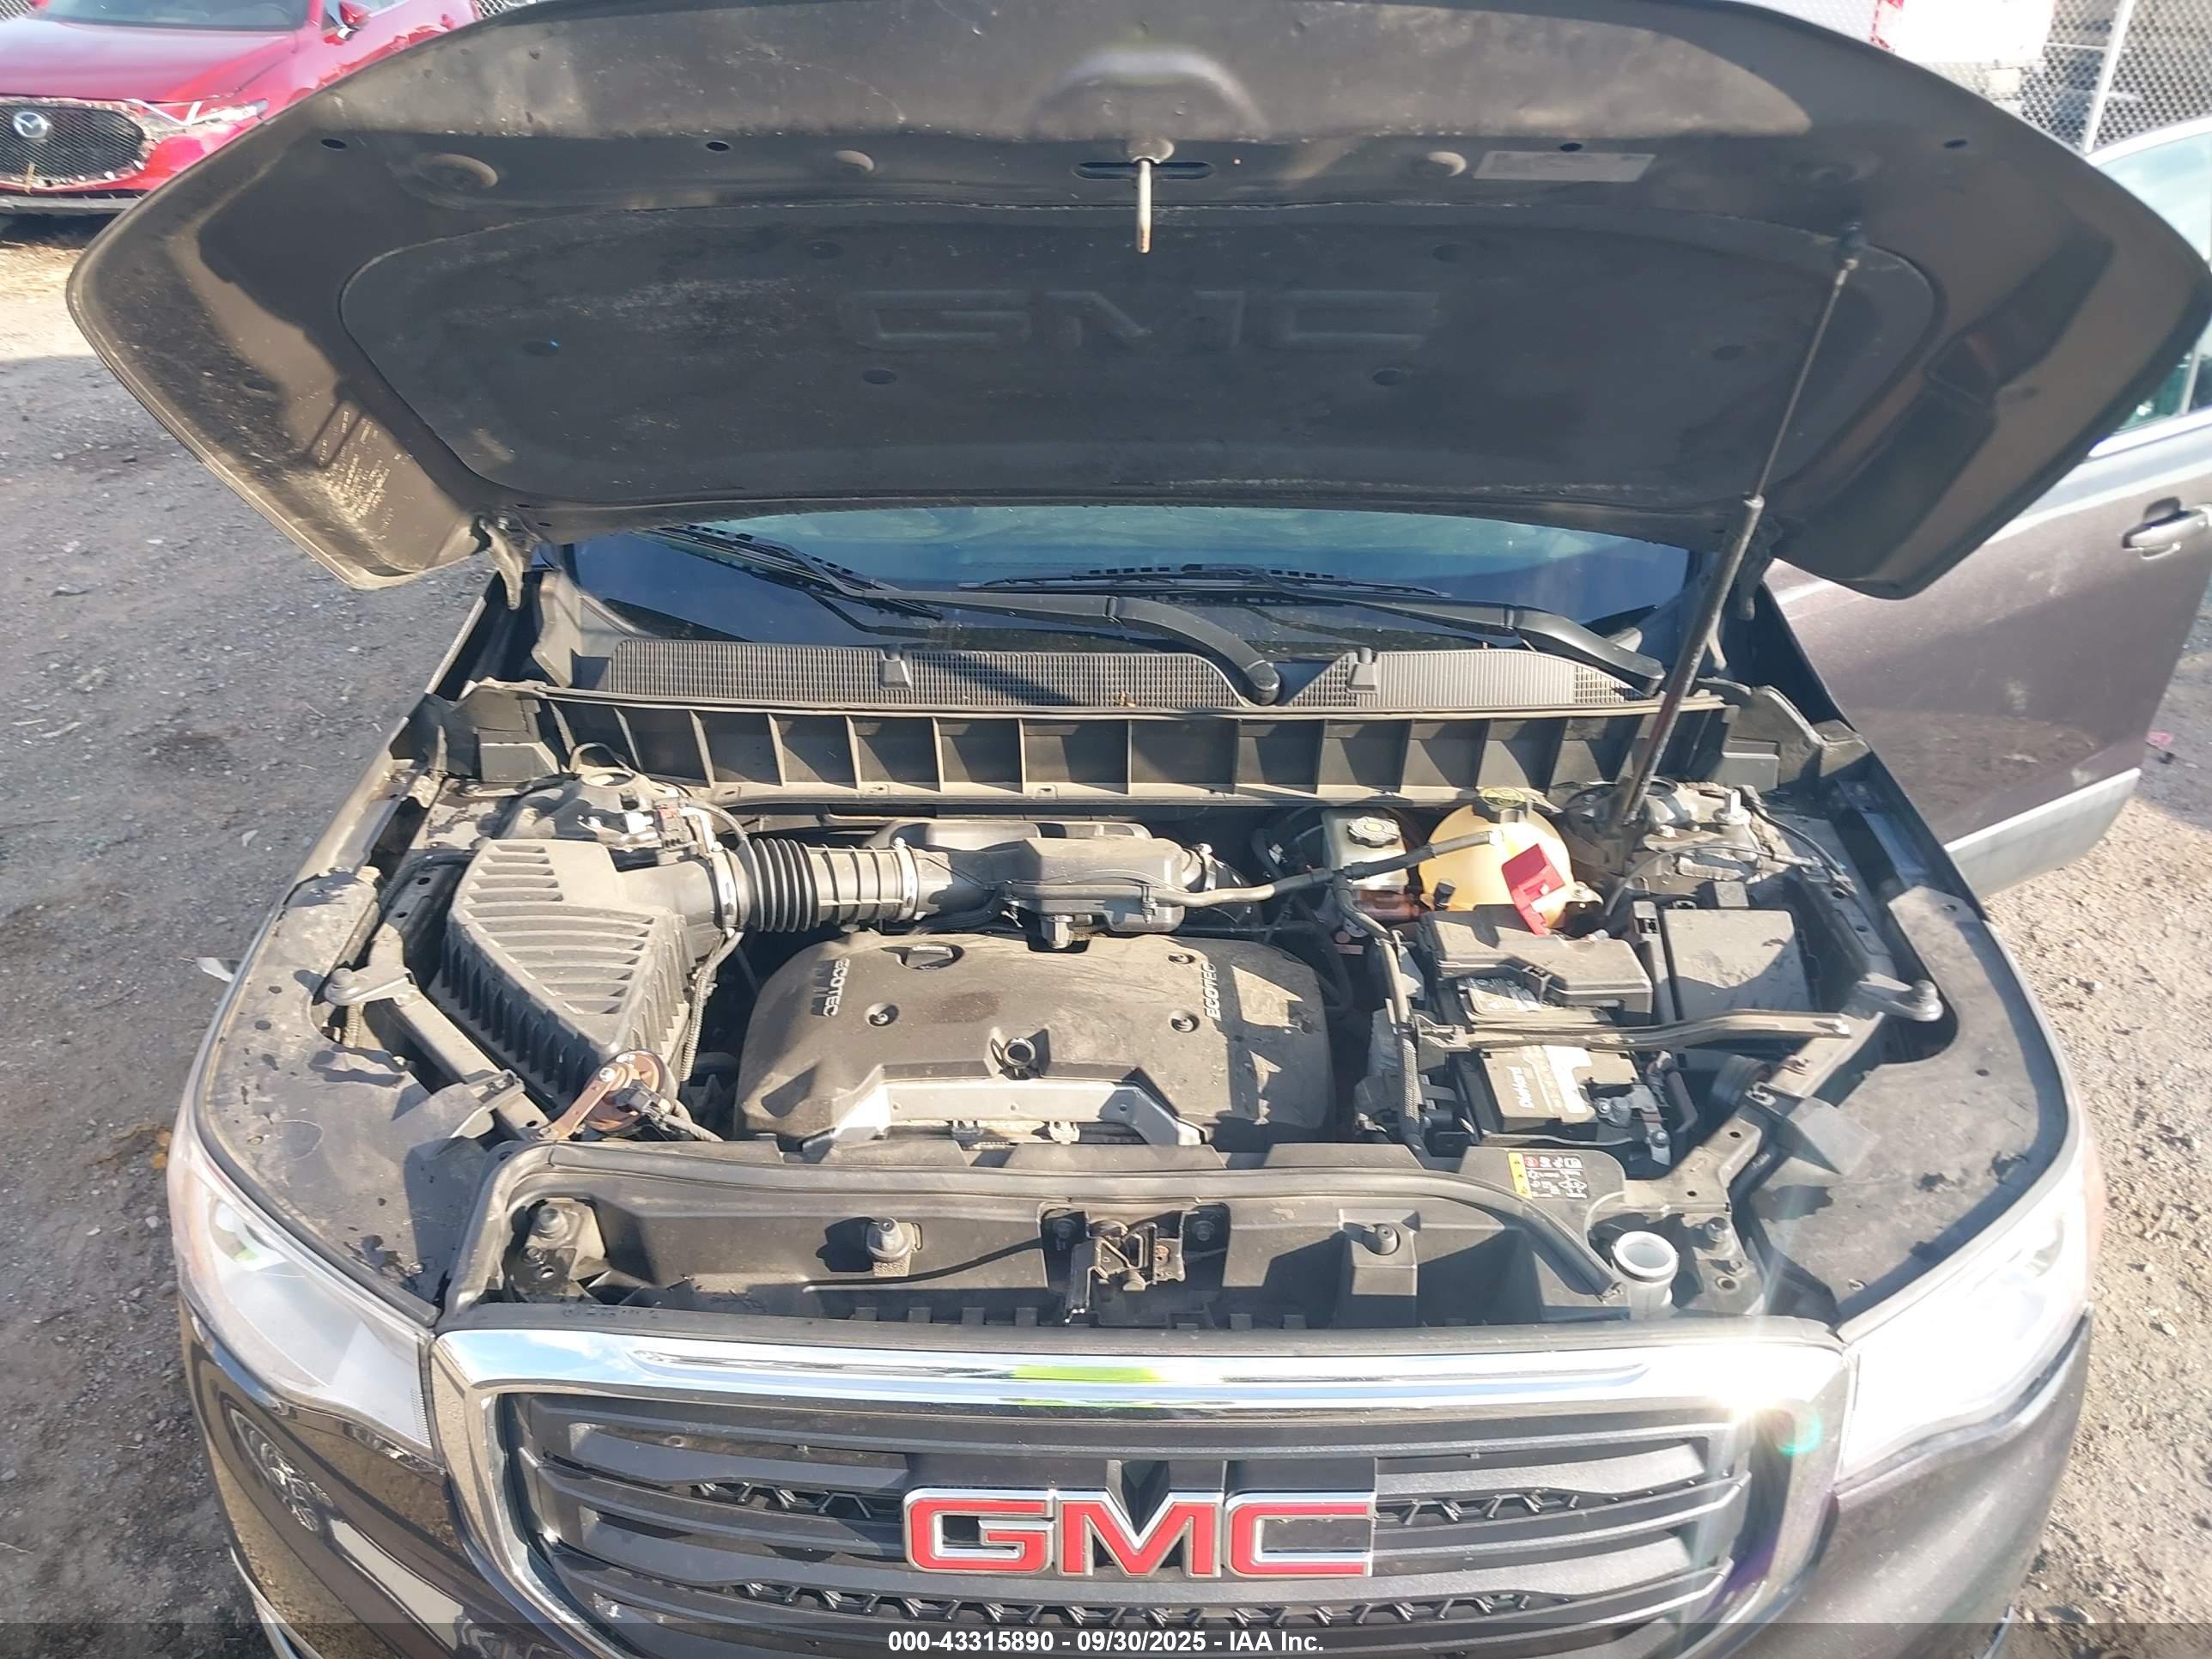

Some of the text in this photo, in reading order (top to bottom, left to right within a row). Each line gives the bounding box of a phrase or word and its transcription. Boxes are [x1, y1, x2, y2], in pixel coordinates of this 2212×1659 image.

[835, 289, 1439, 349] GMC
[823, 957, 850, 1017] ECOTEC
[1202, 963, 1222, 1021] ECOTEC
[904, 1489, 1376, 1578] GMC
